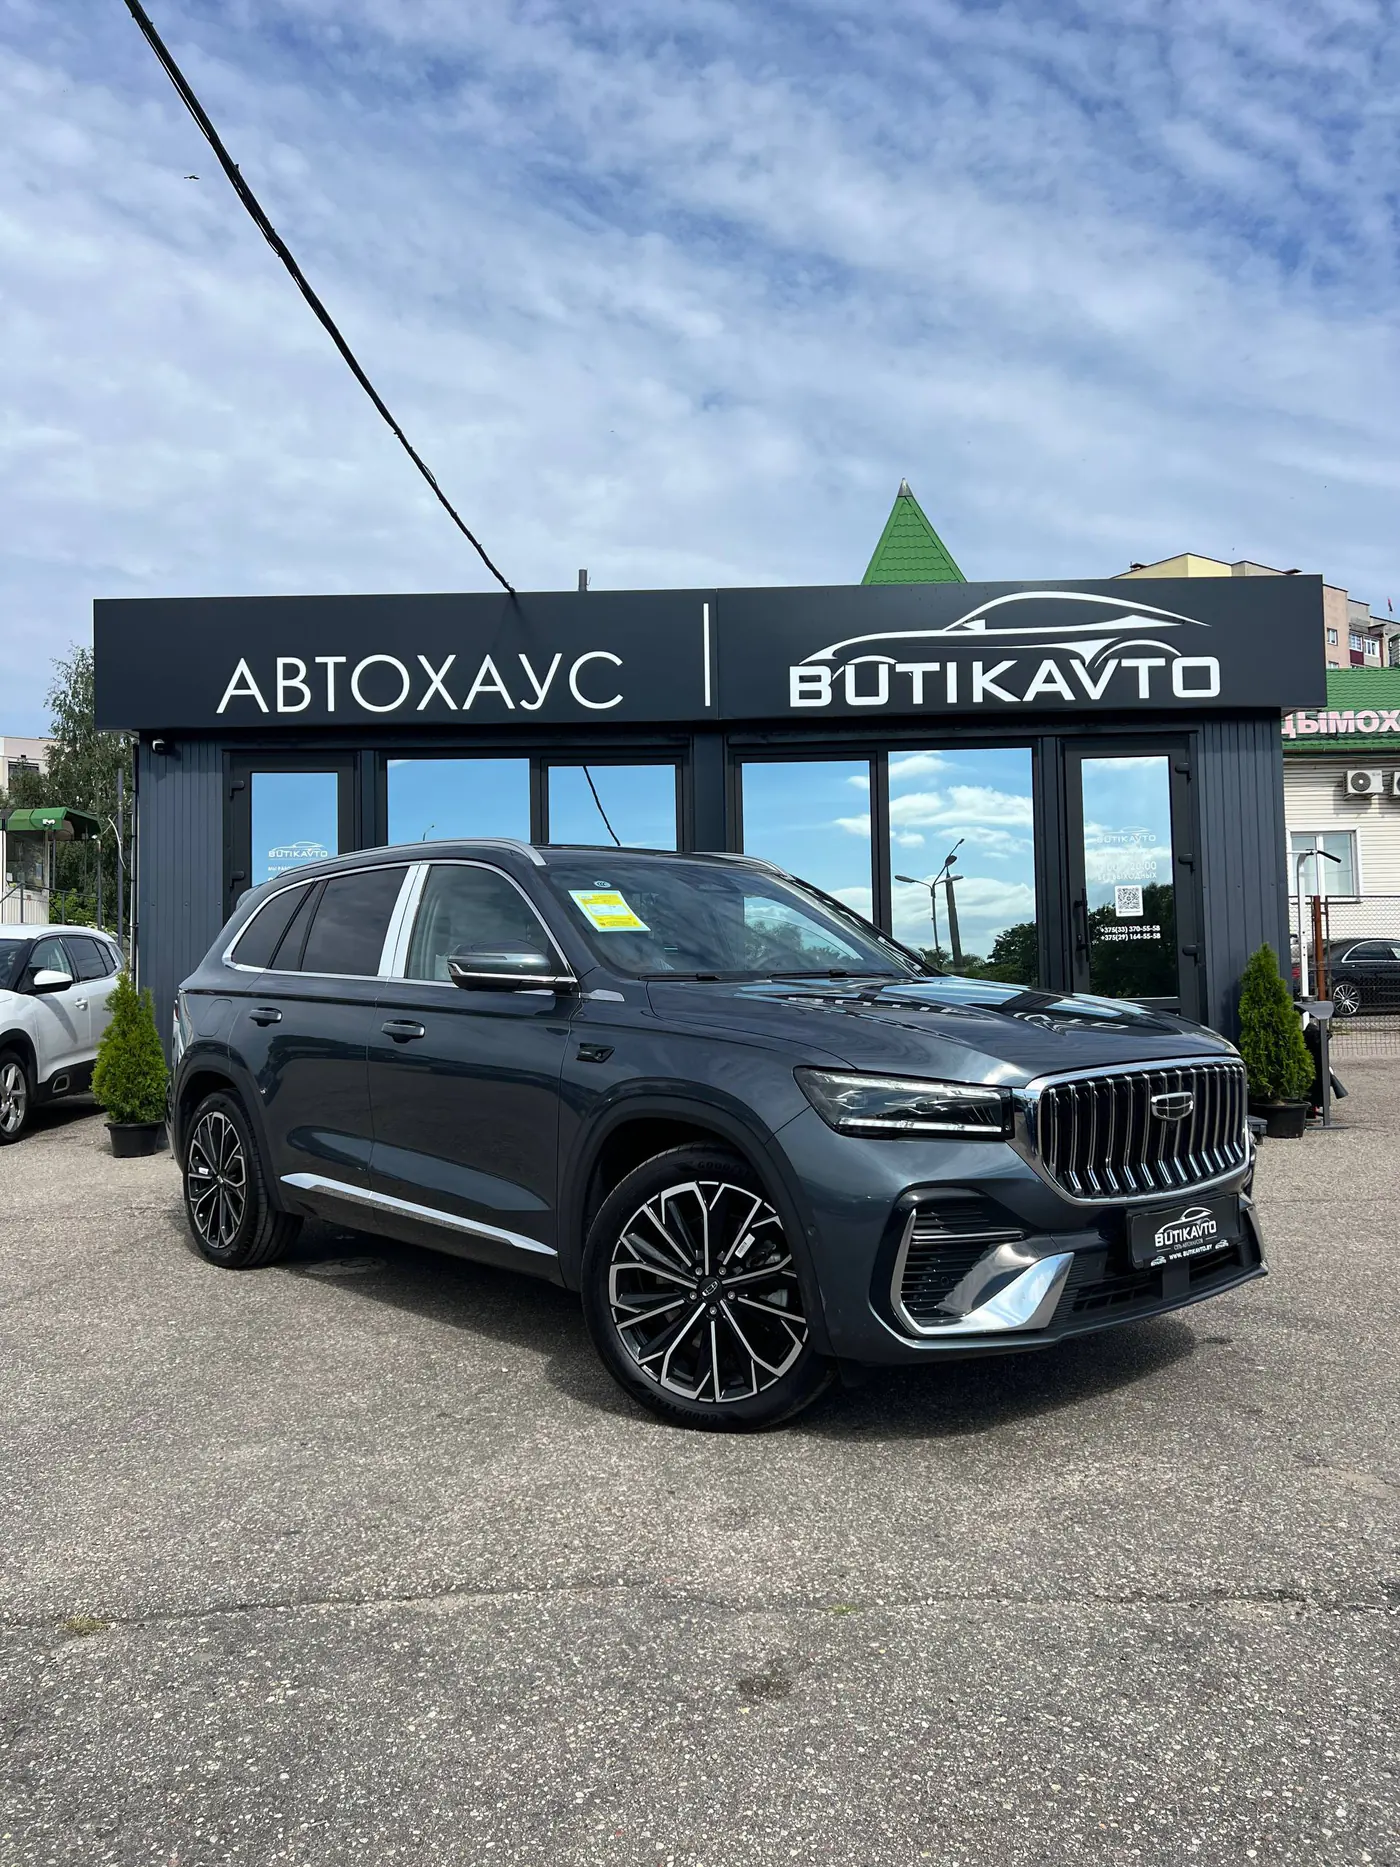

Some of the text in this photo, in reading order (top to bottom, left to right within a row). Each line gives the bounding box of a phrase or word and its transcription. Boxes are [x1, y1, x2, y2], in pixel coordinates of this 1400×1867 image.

[216, 651, 624, 714] АВТОХАУС
[789, 656, 1221, 707] BUTIKAVTO
[268, 850, 328, 858] BUTIKAVTO
[1155, 1220, 1217, 1247] BUTIKAVTO
